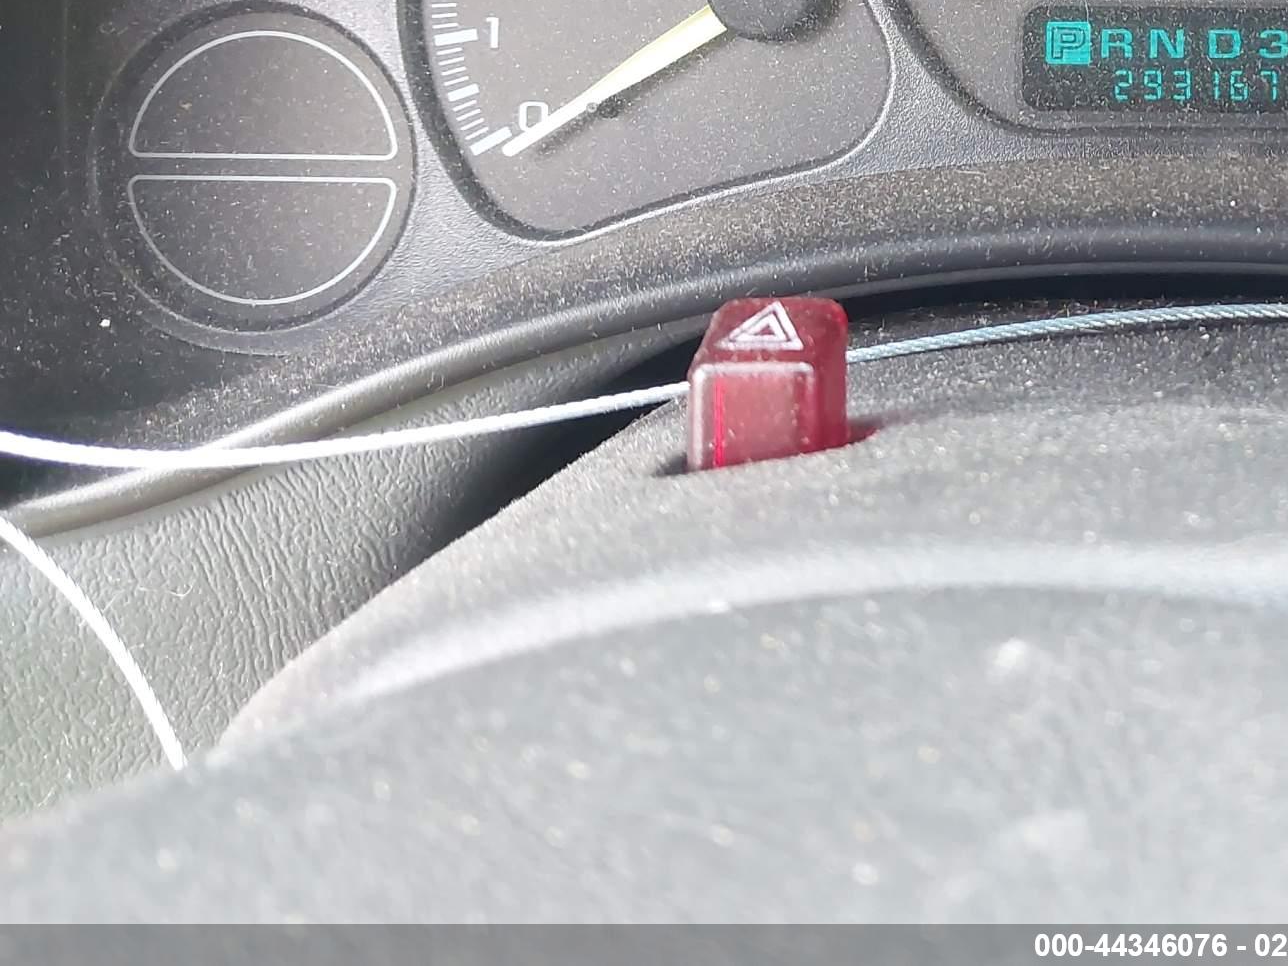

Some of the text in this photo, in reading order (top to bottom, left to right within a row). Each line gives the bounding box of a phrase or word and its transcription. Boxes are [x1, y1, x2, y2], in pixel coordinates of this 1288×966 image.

[485, 16, 499, 49] 1
[1052, 26, 1086, 60] P
[1100, 27, 1134, 60] R
[1150, 28, 1185, 60] N
[1207, 28, 1243, 60] D
[1113, 69, 1280, 101] 293167
[518, 100, 550, 133] 0
